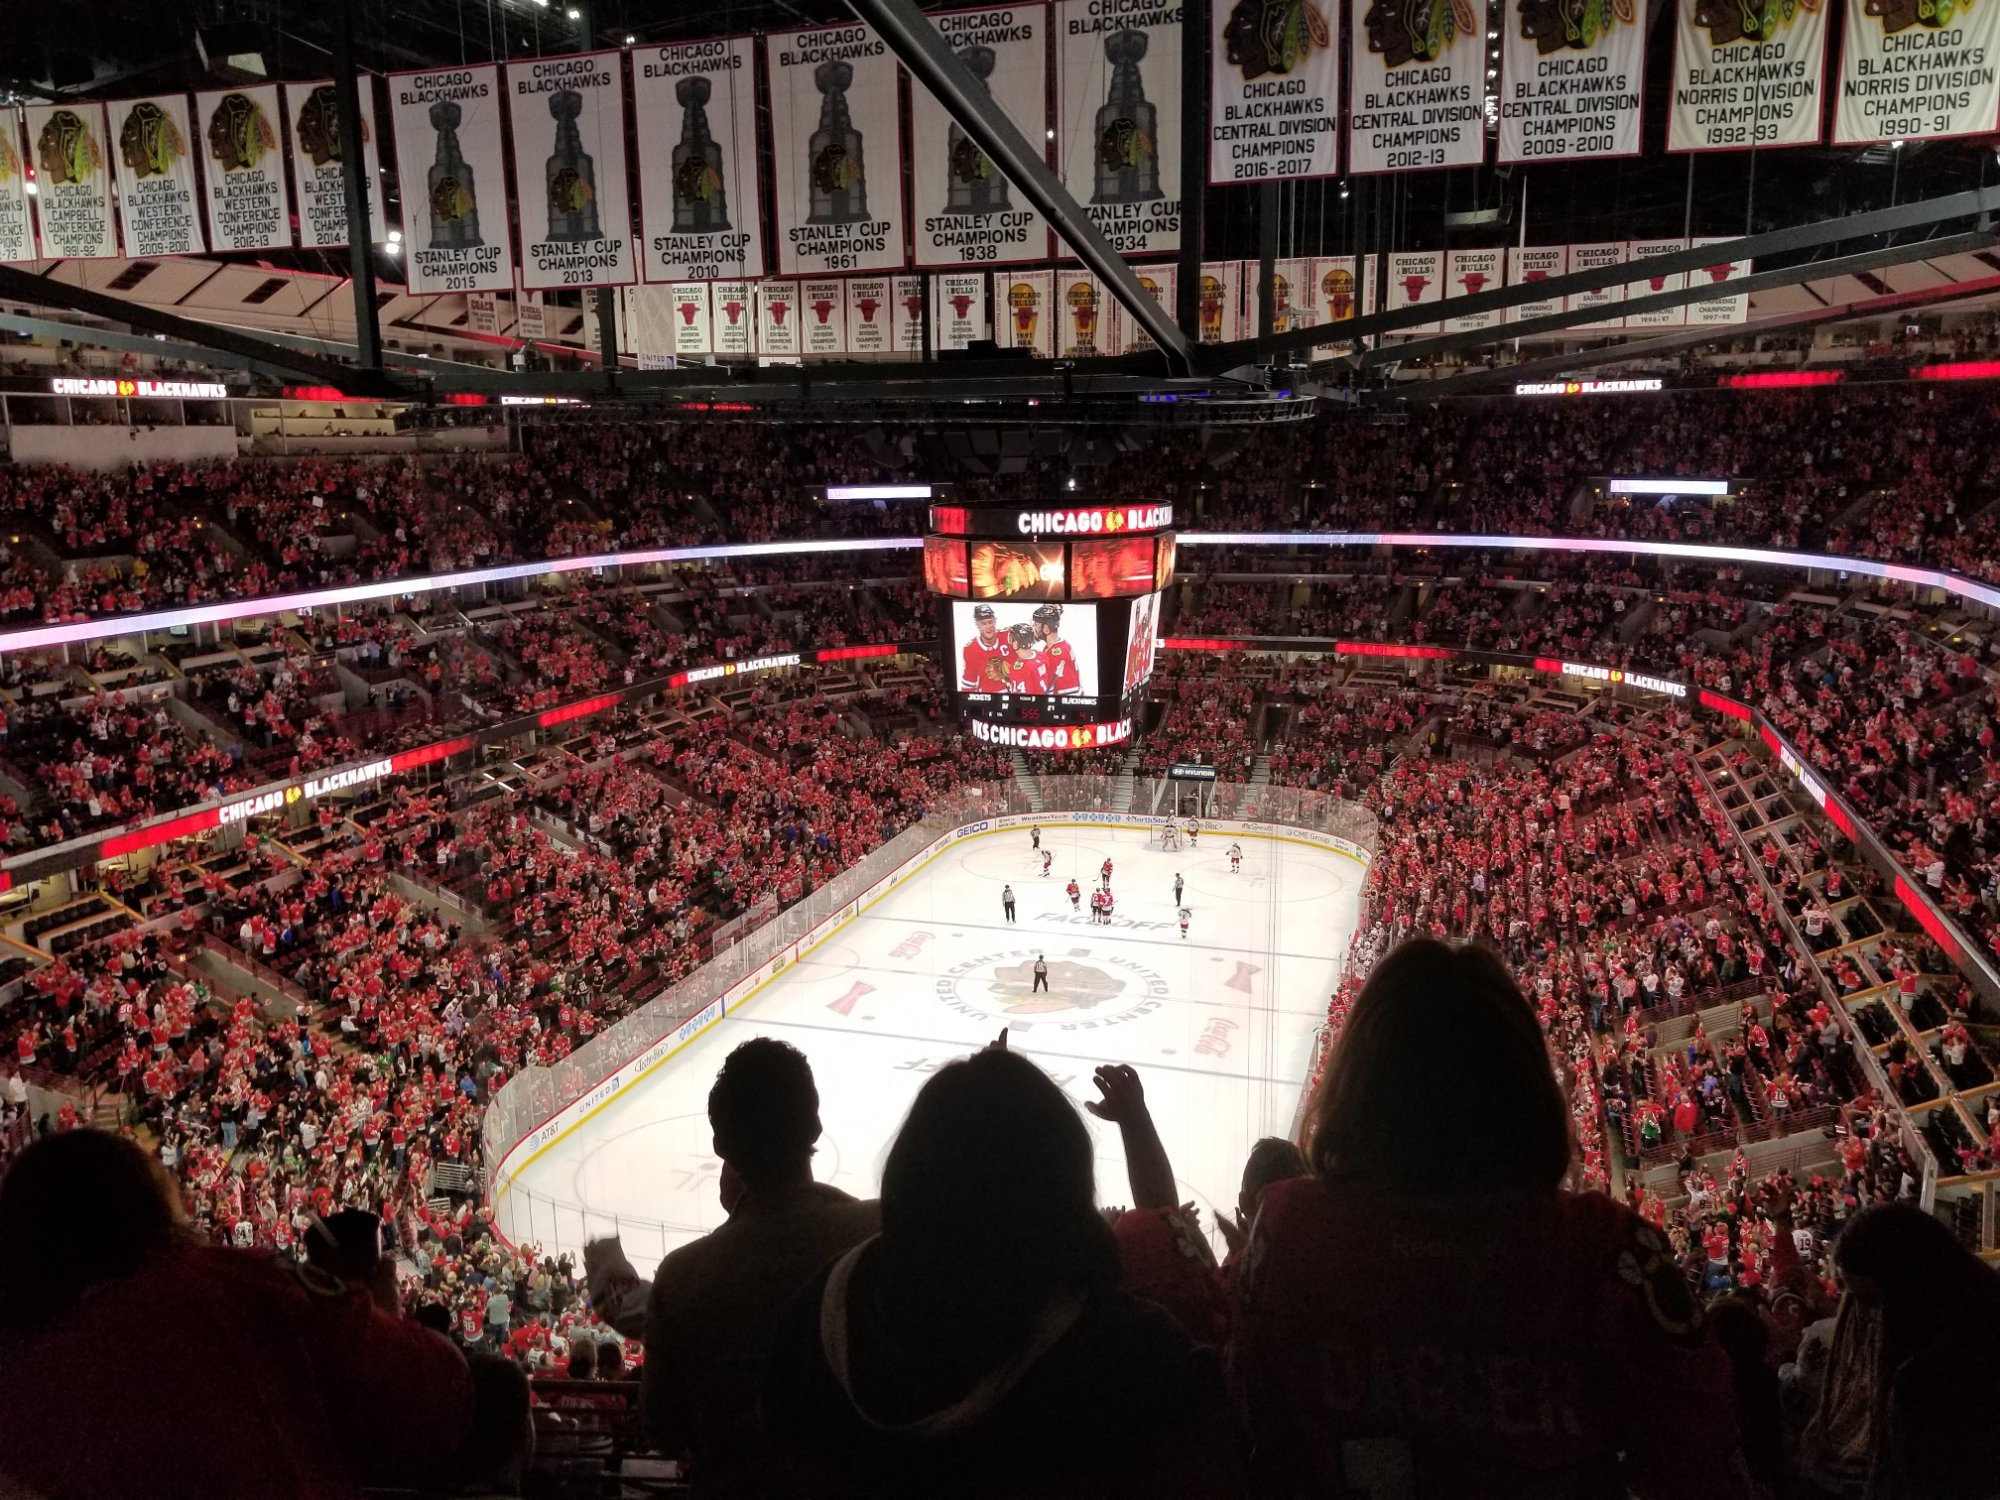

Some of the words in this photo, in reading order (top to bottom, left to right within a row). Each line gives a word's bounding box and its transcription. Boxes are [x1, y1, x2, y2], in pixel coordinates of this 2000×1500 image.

[1089, 0, 1167, 16] CHICAGO
[939, 11, 1013, 32] CHICAGO
[1069, 7, 1184, 35] BLACKHAWKS
[796, 28, 866, 48] CHICAGO
[944, 24, 1032, 47] ACKHAWKS
[1882, 28, 1963, 53] CHICAGO
[659, 42, 725, 61] CHICAGO
[780, 40, 885, 66] BLACKHAWKS
[1712, 43, 1786, 64] CHICAGO
[532, 59, 594, 78] CHICAGO
[644, 55, 742, 78] BLACKHAWKS
[1538, 57, 1608, 77] CHICAGO
[1858, 48, 1984, 76] BLACKHAWKS
[414, 72, 473, 89] CHICAGO
[1385, 66, 1451, 88] CHICAGO
[1689, 60, 1806, 85] BLACKHAWKS
[518, 72, 611, 94] BLACKHAWKS
[1243, 79, 1306, 99] CHICAGO
[1516, 75, 1627, 98] BLACKHAWKS
[1678, 87, 1738, 105] NORRIS
[1744, 79, 1815, 102] DIVISION
[1844, 76, 1910, 98] NORRIS
[1916, 68, 1994, 92] DIVISION
[400, 84, 488, 105] BLACKHAWKS
[1365, 85, 1470, 109] BLACKHAWKS
[1864, 91, 1970, 116] CHAMPIONS
[1225, 98, 1324, 121] BLACKHAWKS
[1502, 99, 1572, 119] CENTRAL
[1576, 93, 1639, 113] DIVISION
[1695, 103, 1794, 125] CHAMPIONS
[1352, 109, 1418, 130] CENTRAL
[1422, 104, 1482, 124] DIVISION
[1523, 115, 1616, 136] CHAMPIONS
[1879, 114, 1951, 136] 1990-91
[1213, 120, 1276, 141] CENTRAL
[1279, 116, 1336, 135] DIVISION
[1372, 127, 1461, 149] CHAMPIONS
[1707, 123, 1778, 144] 1992-93
[1232, 139, 1315, 159] CHAMPIONS
[1522, 135, 1614, 156] 2009-2010
[1387, 148, 1445, 168] 2012-13
[225, 170, 264, 186] CHICAGO
[315, 168, 344, 180] CHICA
[1234, 158, 1311, 179] 2016-2017
[54, 185, 91, 196] CHICAGO
[137, 180, 175, 193] CHICAGO
[214, 181, 277, 199] BLACKHAWKS
[45, 197, 104, 209] BLACKHAWKS
[128, 190, 190, 206] BLACKHAWKS
[224, 196, 270, 210] WESTERN
[314, 194, 343, 206] WEST
[52, 209, 99, 220] CAMPBELL
[138, 204, 182, 218] WESTERN
[218, 207, 280, 224] CONFERENCE
[1084, 203, 1142, 222] TANLEY
[48, 221, 105, 232] CONFERENCE
[132, 215, 192, 230] CONFERENCE
[223, 221, 277, 236] CHAMPIONS
[314, 219, 347, 232] CHAMP
[790, 224, 852, 241] STANLEY
[860, 221, 891, 236] CUP
[925, 214, 992, 232] STANLEY
[1001, 212, 1034, 228] CUP
[53, 233, 103, 244] CHAMPIONS
[138, 228, 188, 242] CHAMPIONS
[233, 234, 269, 248] 2012-13
[654, 235, 714, 250] STANLEY
[721, 233, 751, 248] CUP
[932, 228, 1027, 247] CHAMPIONS
[64, 246, 96, 256] 1991-92
[140, 241, 190, 255] 2009-2010
[415, 249, 468, 264] STANLEY
[475, 246, 501, 260] CUP
[531, 243, 588, 257] STANLEY
[595, 240, 622, 253] CUP
[797, 237, 886, 256] CHAMPIONS
[959, 245, 997, 262] 1938
[1576, 248, 1619, 257] CHICAGO
[1637, 245, 1681, 254] CHICAGO
[538, 254, 618, 270] CHAMPIONS
[661, 249, 746, 265] CHAMPIONS
[824, 255, 857, 270] 1961
[1396, 257, 1436, 266] CHICAGO
[1454, 254, 1496, 263] CHICAGO
[1523, 261, 1552, 269] BULLS
[1583, 257, 1613, 266] BULLS
[422, 261, 498, 277] CHAMPIONS
[563, 269, 593, 283] 2013
[687, 265, 719, 279] 2010
[1461, 263, 1490, 272] BULLS
[446, 277, 476, 290] 2015
[53, 378, 117, 395] CHICAGO
[137, 381, 227, 398] BLACKHAWKS
[1516, 383, 1566, 395] CHICAGO
[1581, 379, 1662, 393] BLACKHAWKS
[1018, 511, 1102, 534] CHICAGO
[687, 666, 724, 682] CHICAGO
[736, 655, 800, 674] BLACKHAWKS
[1561, 662, 1609, 680] CHICAGO
[1624, 672, 1687, 697] BLACKHAWKS
[988, 724, 1068, 748] CHICAGO
[1096, 718, 1131, 744] BLACK
[218, 791, 283, 824] CHICAGO
[304, 759, 393, 799] BLACKHAWKS
[957, 822, 988, 838] GEICO
[1294, 830, 1309, 838] CME
[1109, 956, 1170, 995] UNITED
[936, 979, 988, 1021] UNITED
[579, 1086, 610, 1113] UNITED
[541, 1121, 560, 1143] AT&T
